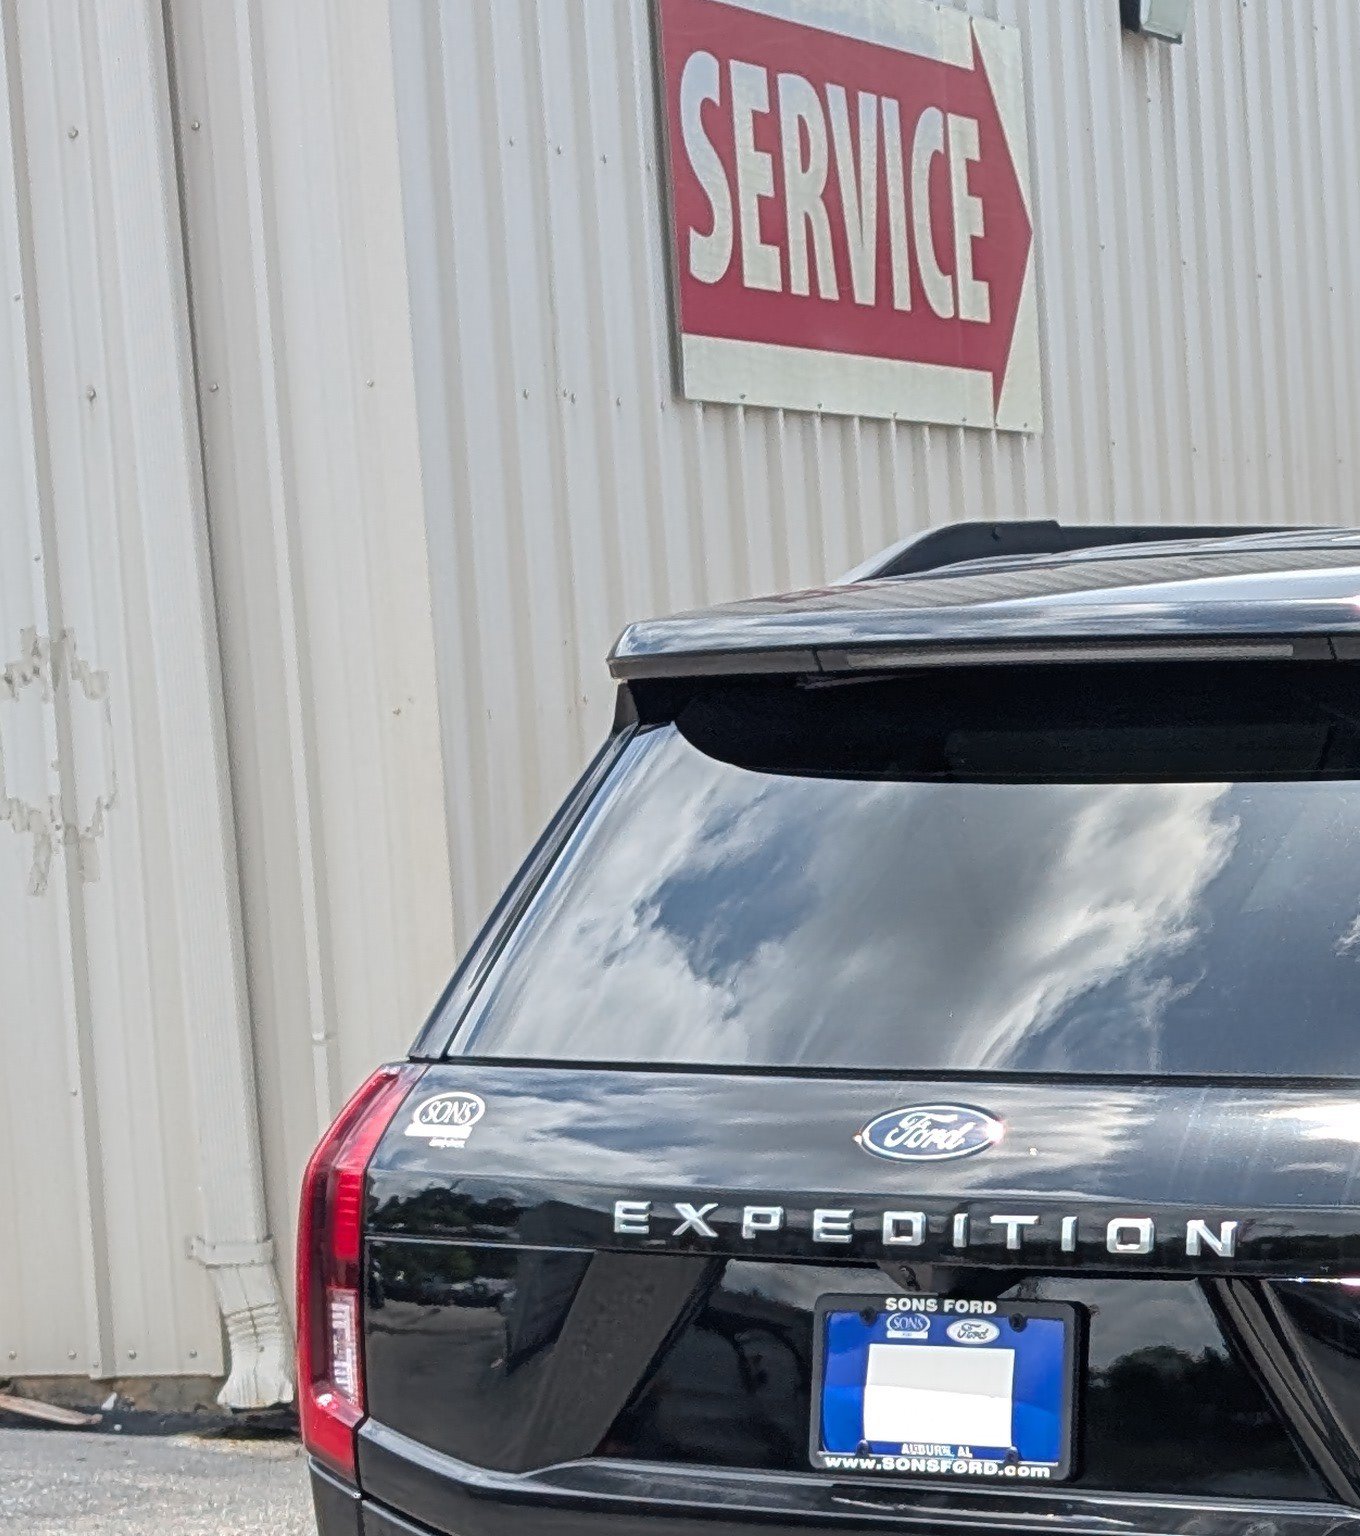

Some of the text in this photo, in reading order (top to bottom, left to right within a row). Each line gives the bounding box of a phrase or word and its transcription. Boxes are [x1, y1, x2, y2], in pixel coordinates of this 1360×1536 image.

[680, 50, 990, 324] SERVICE
[421, 1100, 477, 1124] SONS
[884, 1112, 977, 1150] Ford
[613, 1200, 1239, 1258] EXPEDITION
[885, 1297, 997, 1314] SONS FORD
[893, 1316, 924, 1331] SONS
[957, 1322, 989, 1340] Ford
[957, 1445, 973, 1459] AL
[825, 1456, 1051, 1478] www.SONSFORD.com
